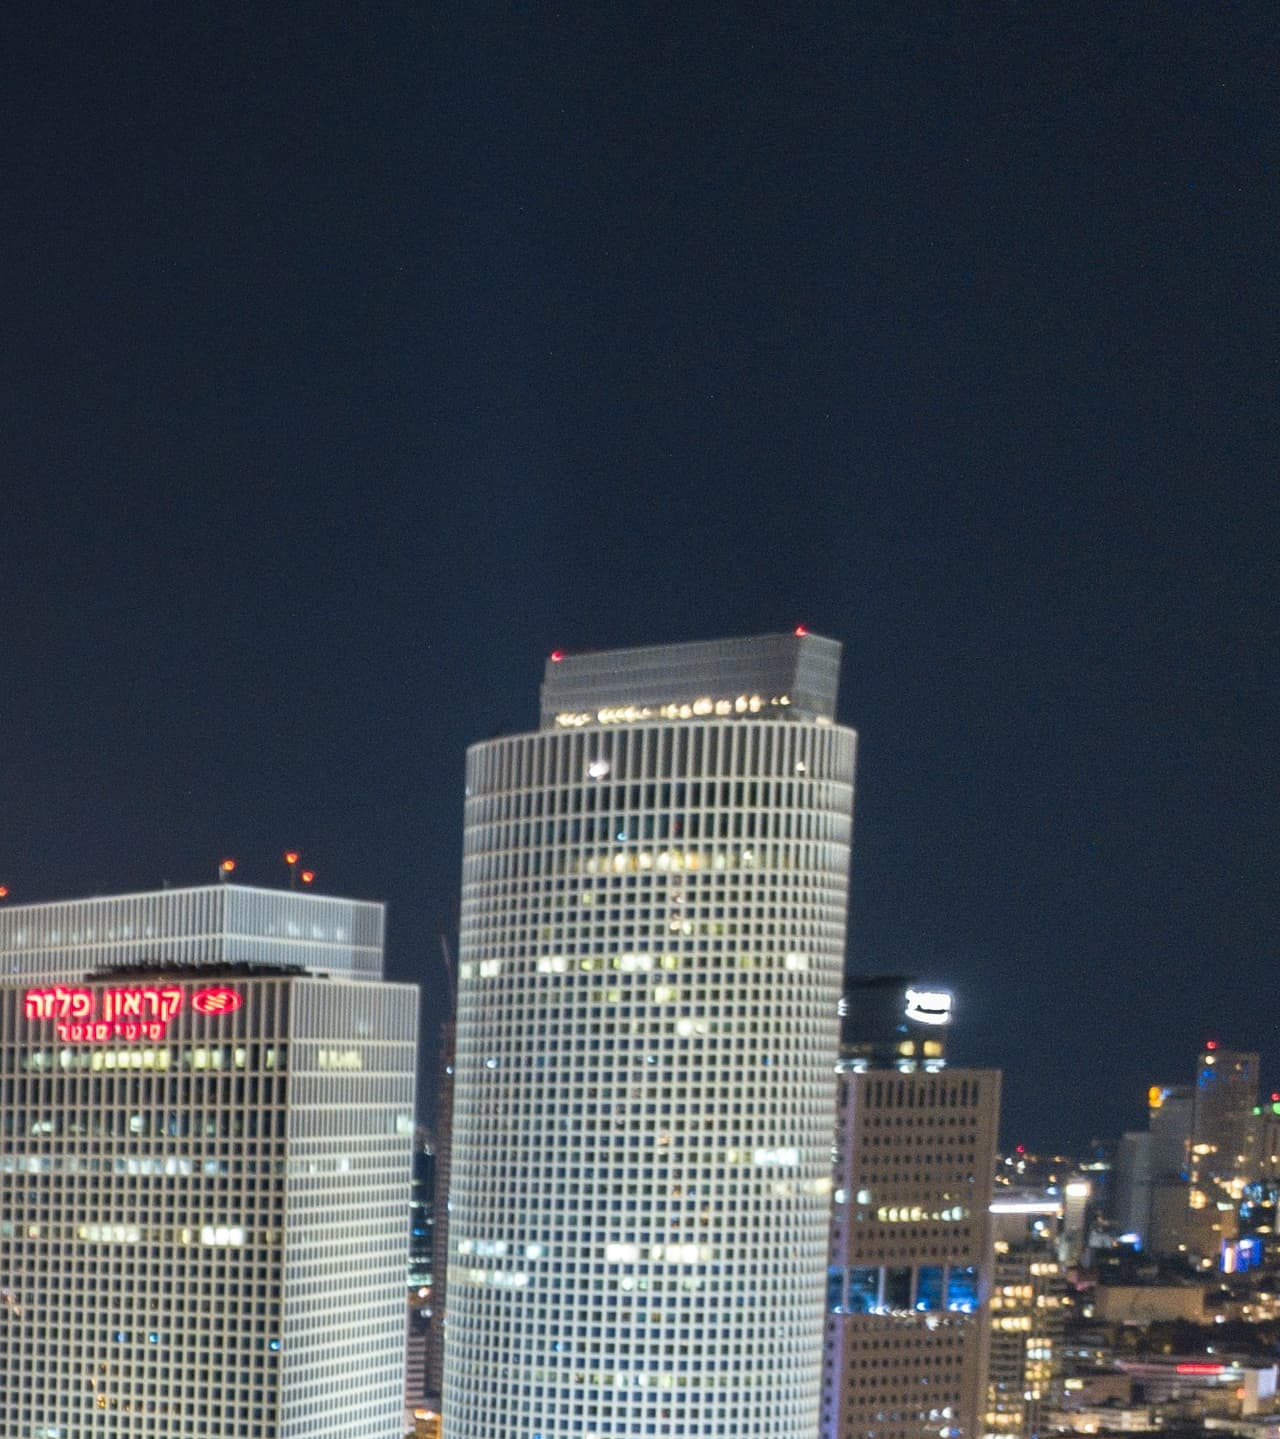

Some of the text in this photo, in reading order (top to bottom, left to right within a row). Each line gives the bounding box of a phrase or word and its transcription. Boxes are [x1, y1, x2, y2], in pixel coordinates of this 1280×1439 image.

[26, 987, 181, 1022] קראון פלזה
[57, 1024, 162, 1042] סיטי סנטר
